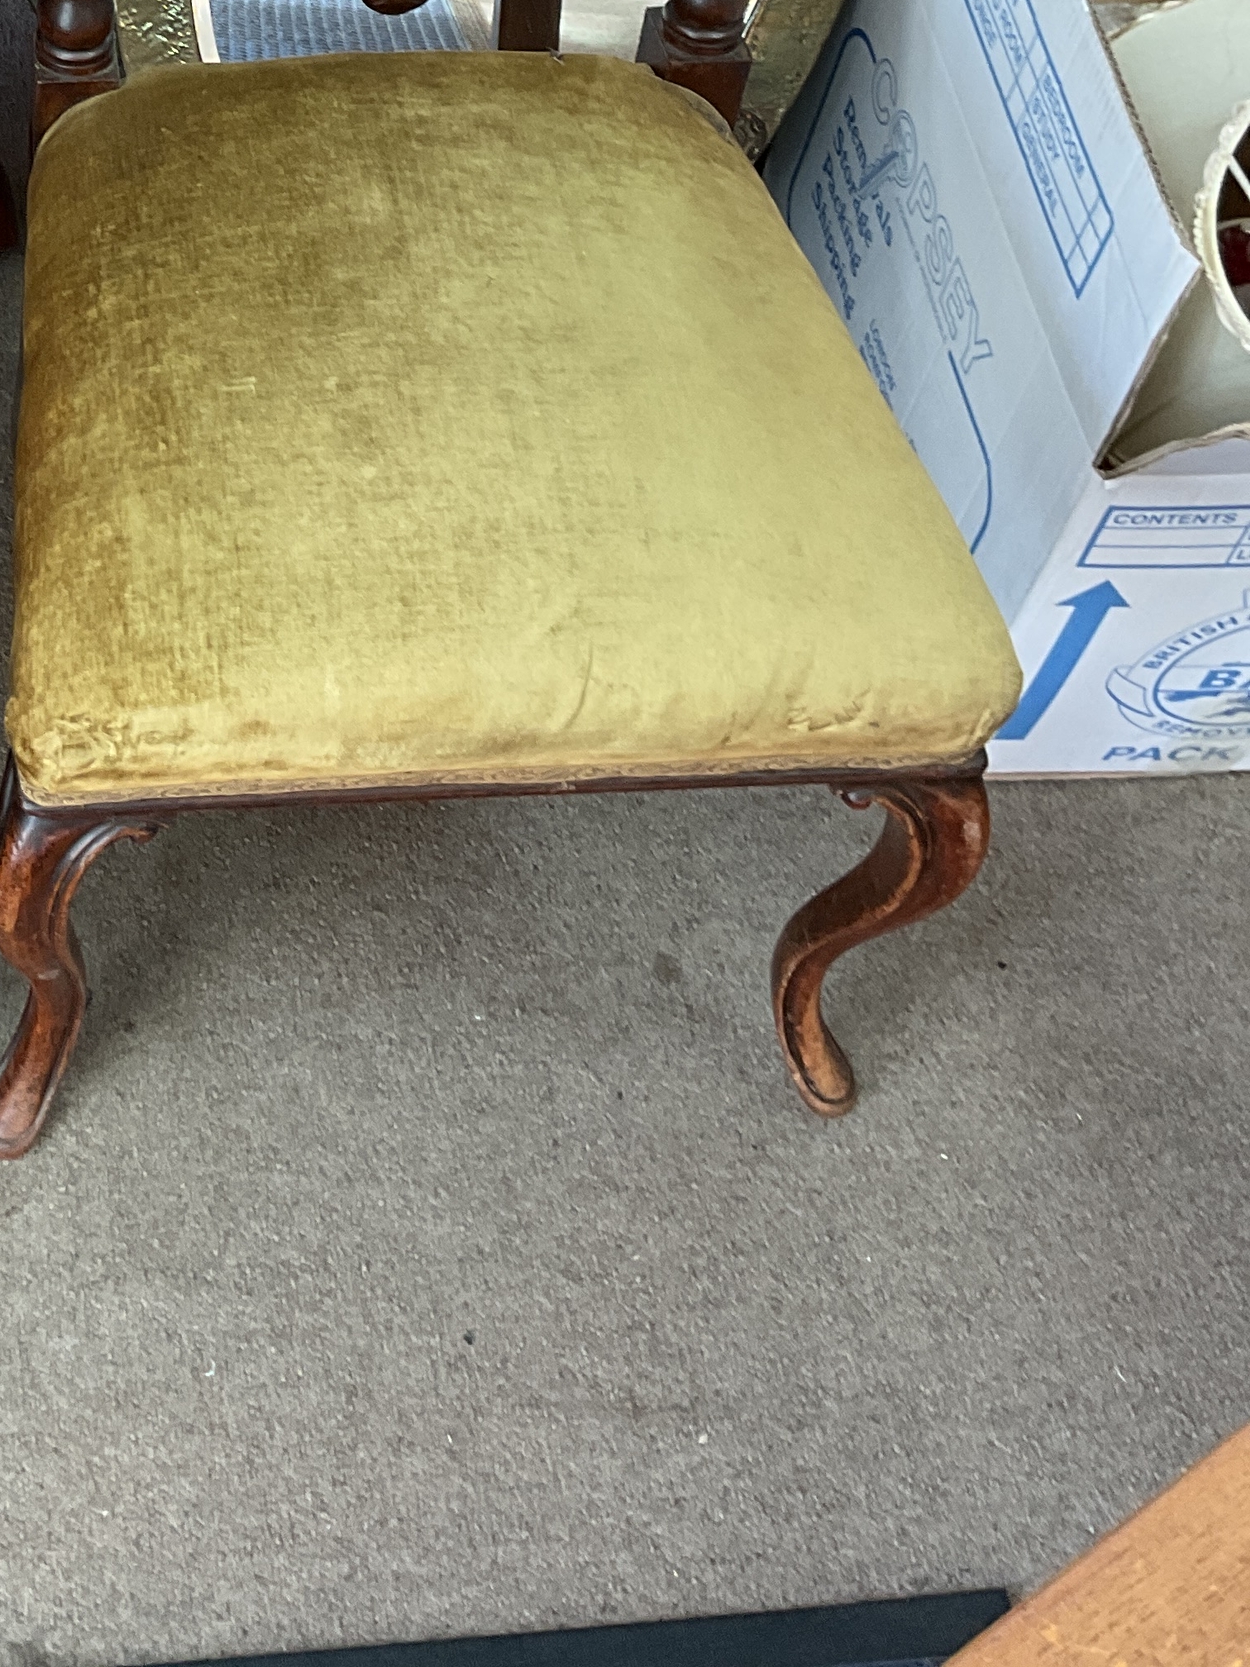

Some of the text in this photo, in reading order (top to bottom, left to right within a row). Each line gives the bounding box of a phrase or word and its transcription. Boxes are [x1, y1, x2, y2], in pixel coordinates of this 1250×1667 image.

[1000, 8, 1023, 68] ROOM
[1032, 97, 1060, 160] STUDY
[1043, 73, 1085, 179] BEDROOM
[833, 126, 873, 248] Storage
[1022, 122, 1057, 219] GENERAL
[811, 181, 855, 320] Shipping
[822, 151, 861, 277] Packing
[1113, 512, 1238, 525] CONTENTS
[1143, 616, 1238, 669] BRITISH
[1102, 745, 1239, 761] PACK
